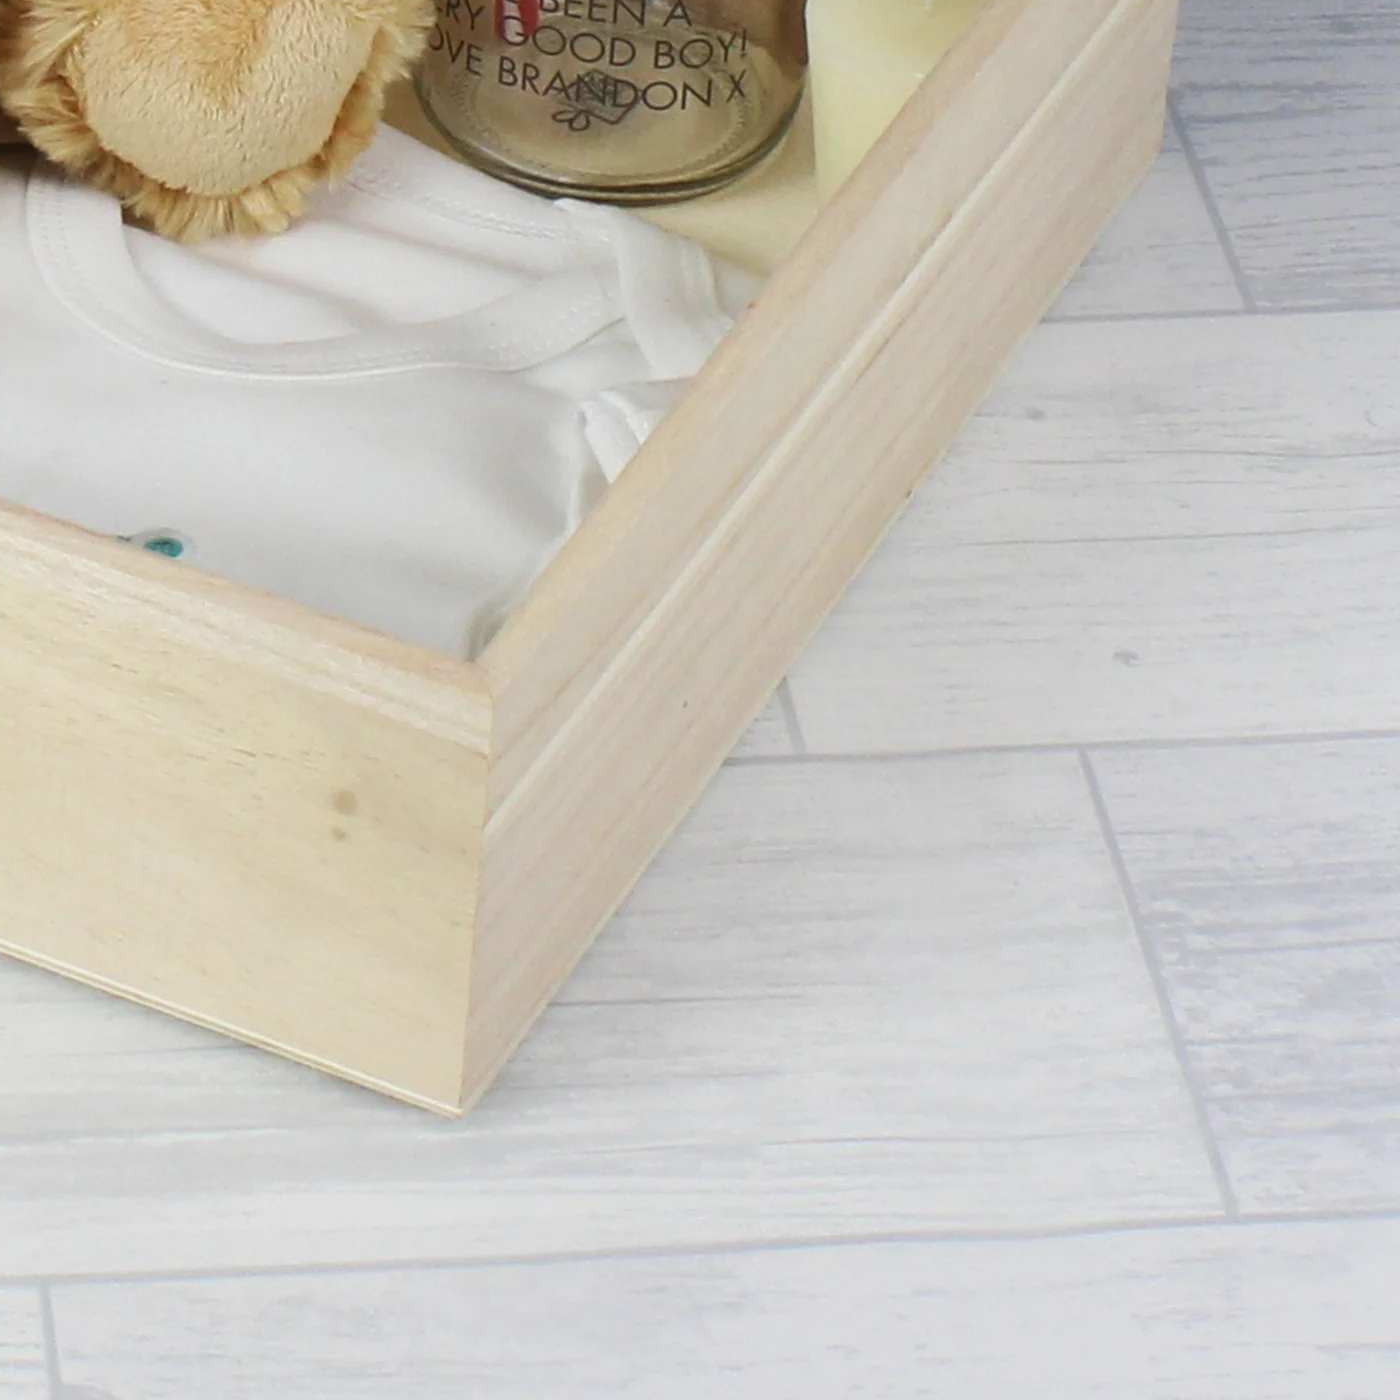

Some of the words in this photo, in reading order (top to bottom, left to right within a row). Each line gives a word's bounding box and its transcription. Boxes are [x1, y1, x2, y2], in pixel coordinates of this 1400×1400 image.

[501, 15, 637, 67] GOOD
[653, 28, 748, 70] BOY!
[499, 56, 714, 111] BRANDON
